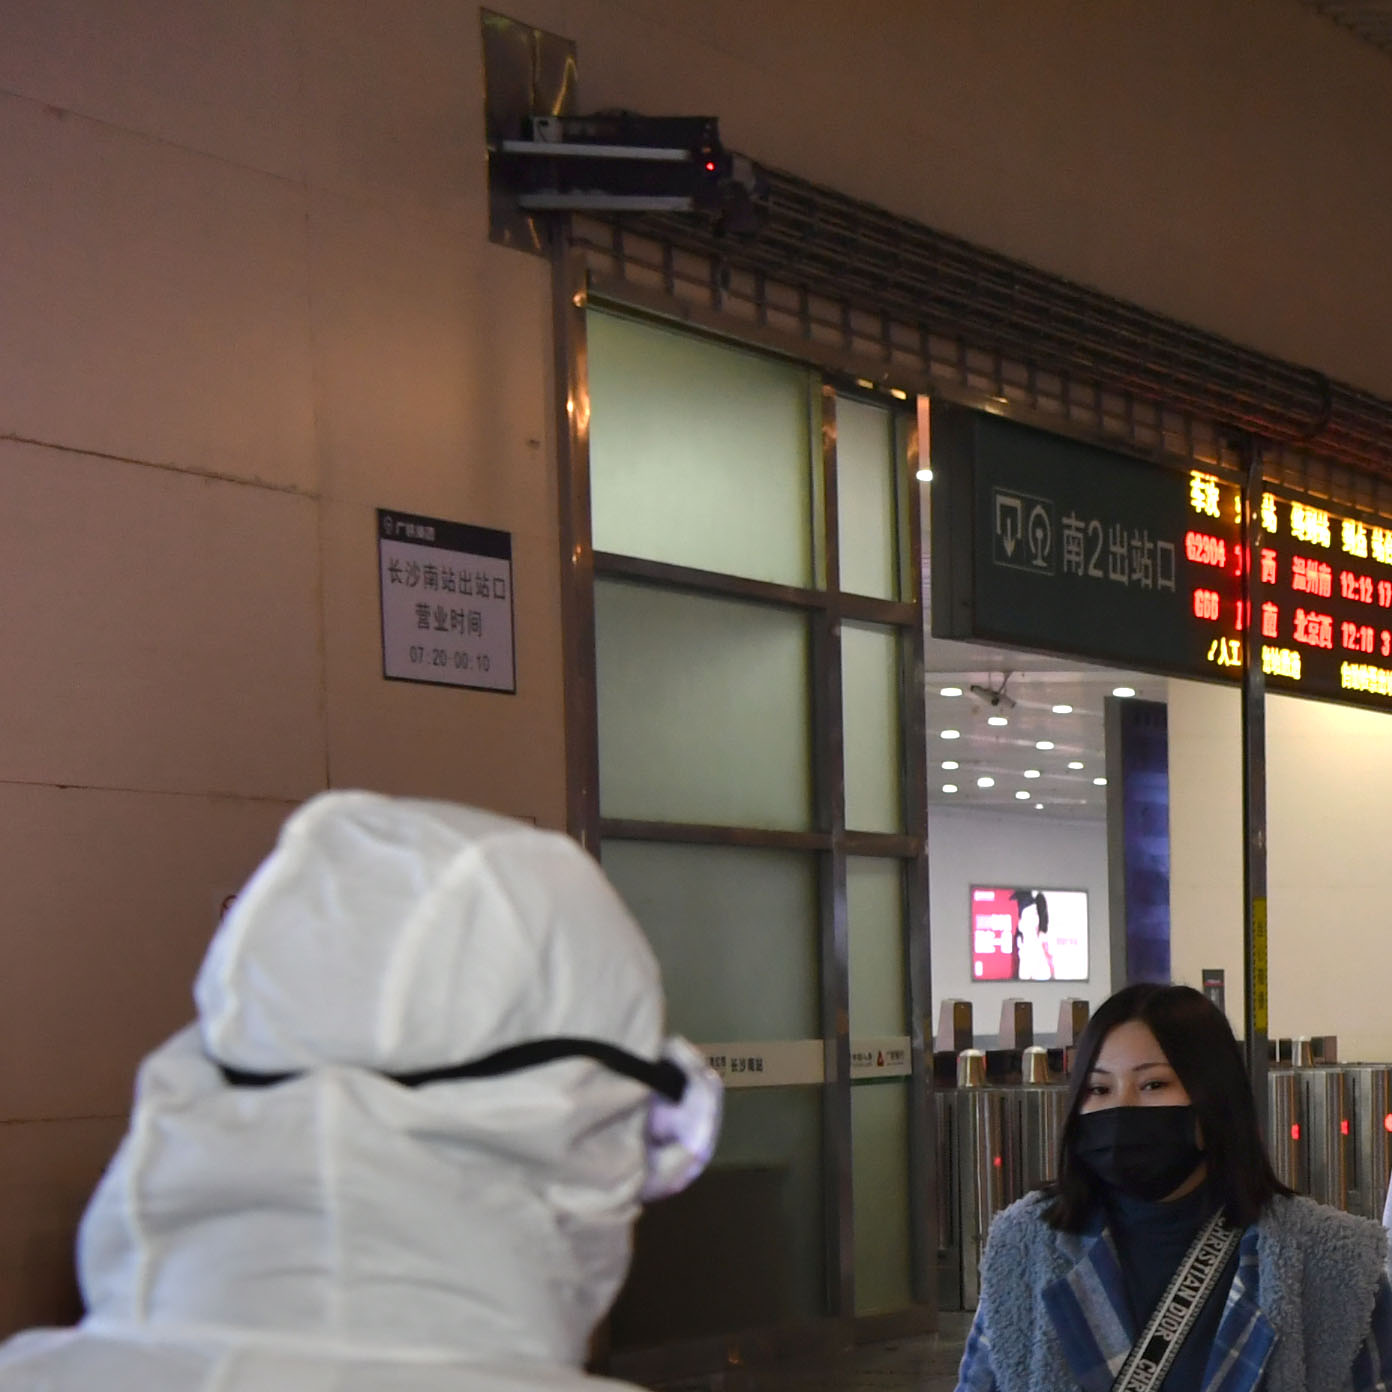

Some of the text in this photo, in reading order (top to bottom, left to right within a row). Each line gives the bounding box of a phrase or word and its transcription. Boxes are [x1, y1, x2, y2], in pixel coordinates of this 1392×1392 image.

[1190, 470, 1220, 518] 车次
[1061, 511, 1176, 593] 南2出站口
[1185, 532, 1225, 567] G2304
[1292, 555, 1332, 598] 温州南
[1339, 570, 1374, 604] 12:12
[1377, 580, 1392, 608] 17
[388, 557, 506, 600] 长沙南站出站口
[414, 602, 482, 637] 营业时间
[1293, 608, 1334, 649] 北京西
[1381, 630, 1392, 657] 3
[1154, 1302, 1189, 1341] DIOR
